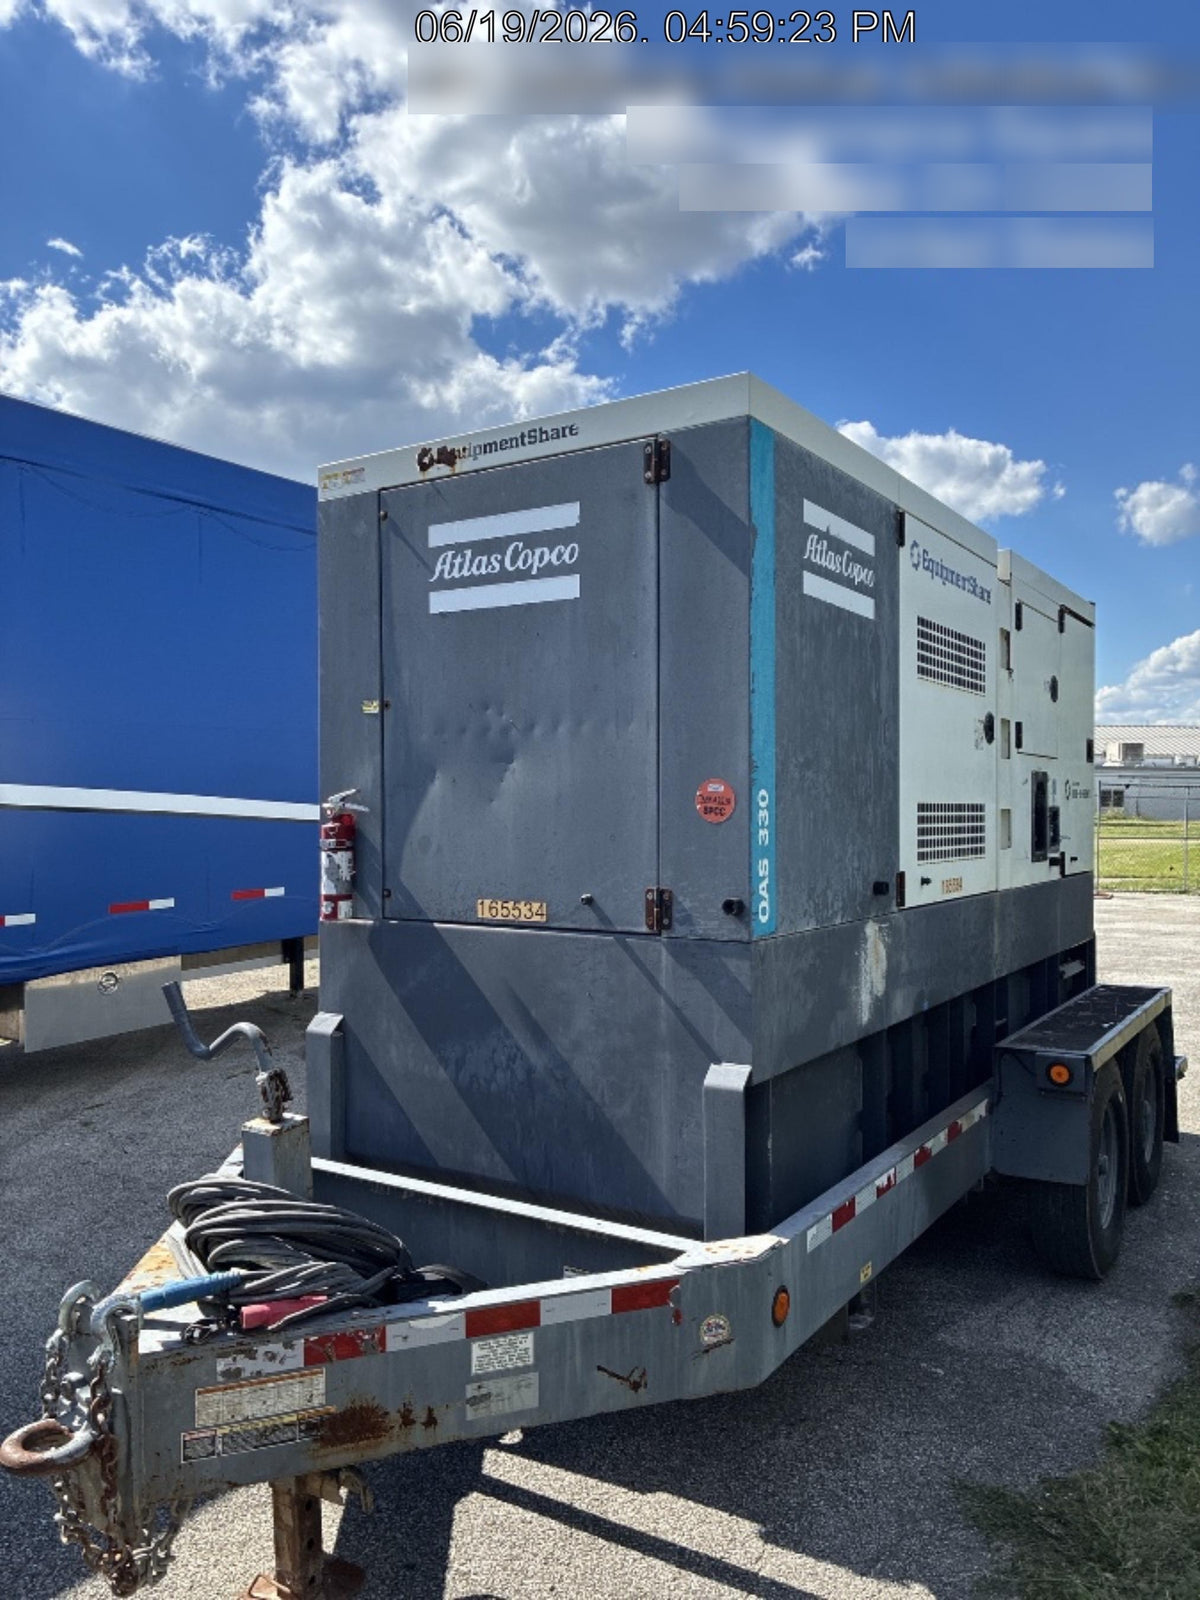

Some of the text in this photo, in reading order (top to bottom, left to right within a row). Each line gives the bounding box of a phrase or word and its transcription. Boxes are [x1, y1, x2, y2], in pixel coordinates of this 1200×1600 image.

[428, 541, 579, 583] Atlas Copco
[803, 533, 842, 574] Atlas
[757, 788, 770, 847] 330
[478, 900, 545, 920] 165534
